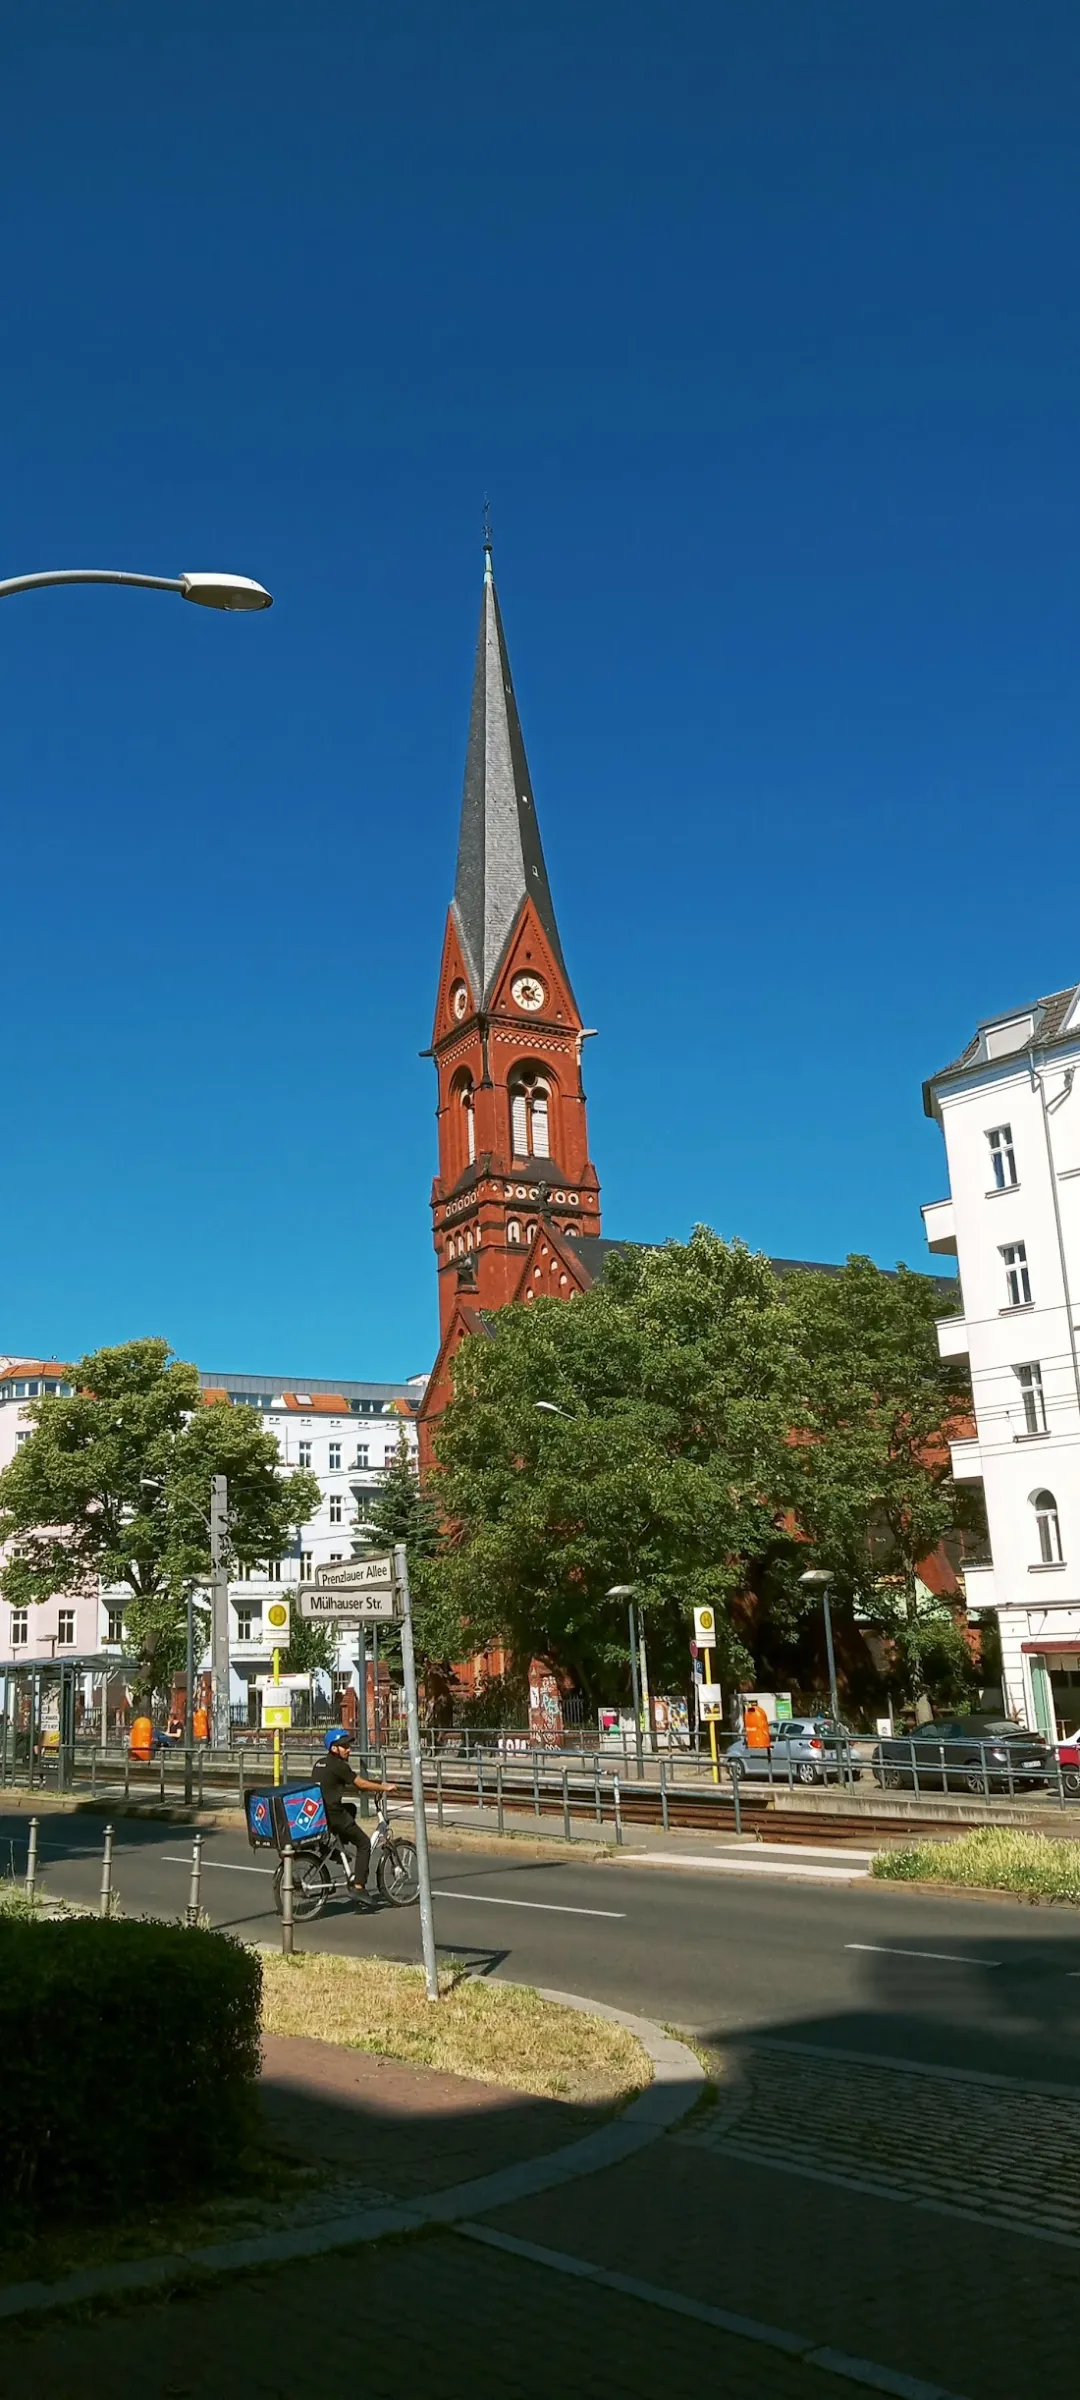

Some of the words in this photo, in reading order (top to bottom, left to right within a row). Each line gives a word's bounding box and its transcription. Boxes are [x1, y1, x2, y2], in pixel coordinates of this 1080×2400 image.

[322, 1570, 364, 1587] Prenzlauer
[366, 1565, 388, 1578] Allee
[310, 1597, 363, 1610] Mülhauser
[366, 1597, 383, 1610] Str.
